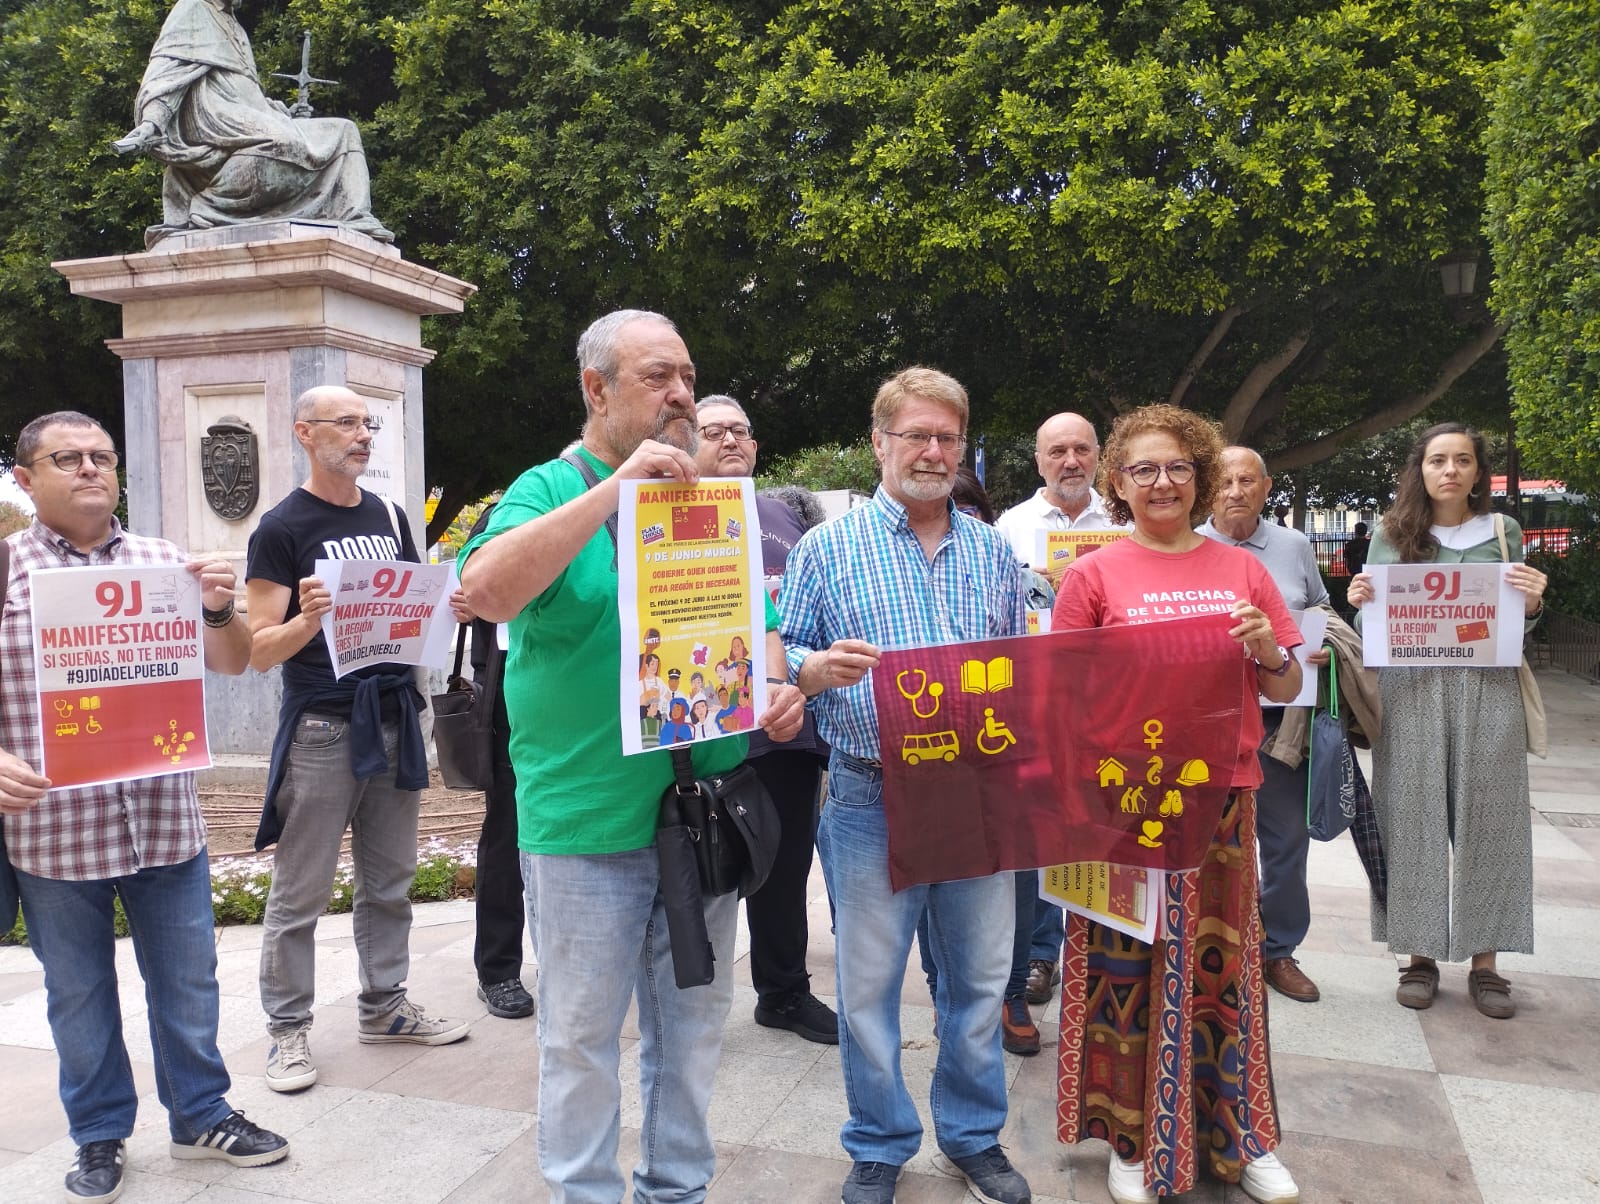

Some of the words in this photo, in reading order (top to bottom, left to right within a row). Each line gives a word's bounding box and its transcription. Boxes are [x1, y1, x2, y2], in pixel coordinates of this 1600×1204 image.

[639, 486, 742, 504] MANIFESTACIÓN
[645, 552, 652, 564] 9
[654, 552, 669, 562] DE
[671, 549, 702, 561] JUNIO
[652, 569, 685, 579] GOBIERNE
[687, 567, 706, 576] QUIEN
[708, 564, 738, 574] GOBIERNE
[372, 568, 414, 599] 9J
[650, 584, 668, 594] OTRA
[670, 581, 693, 592] REGIÓN
[696, 581, 704, 589] ES
[706, 578, 740, 589] NECESARIA
[1424, 570, 1461, 600] 9J
[95, 580, 143, 618] 9J
[1142, 590, 1236, 604] MARCHAS
[334, 602, 434, 622] MANIFESTACIÓN
[1126, 607, 1149, 617] DE
[1154, 606, 1176, 615] LA
[1388, 602, 1496, 620] MANIFESTACIÓN
[41, 616, 198, 649] MANIFESTACIÓN
[336, 625, 343, 638] LA
[345, 619, 374, 636] REGIÓN
[1390, 624, 1401, 634] LA
[1403, 621, 1437, 634] REGIÓN
[336, 636, 351, 652] ERES
[1390, 635, 1413, 646] ERES
[44, 654, 56, 669] SI
[59, 648, 114, 668] SUEÑAS,
[118, 651, 134, 664] NO
[137, 648, 152, 661] TE
[155, 644, 198, 660] RINDAS
[1391, 645, 1474, 658] #9JDÍADELPUEBLO
[66, 662, 179, 684] #9JDÍADELPUEBLO
